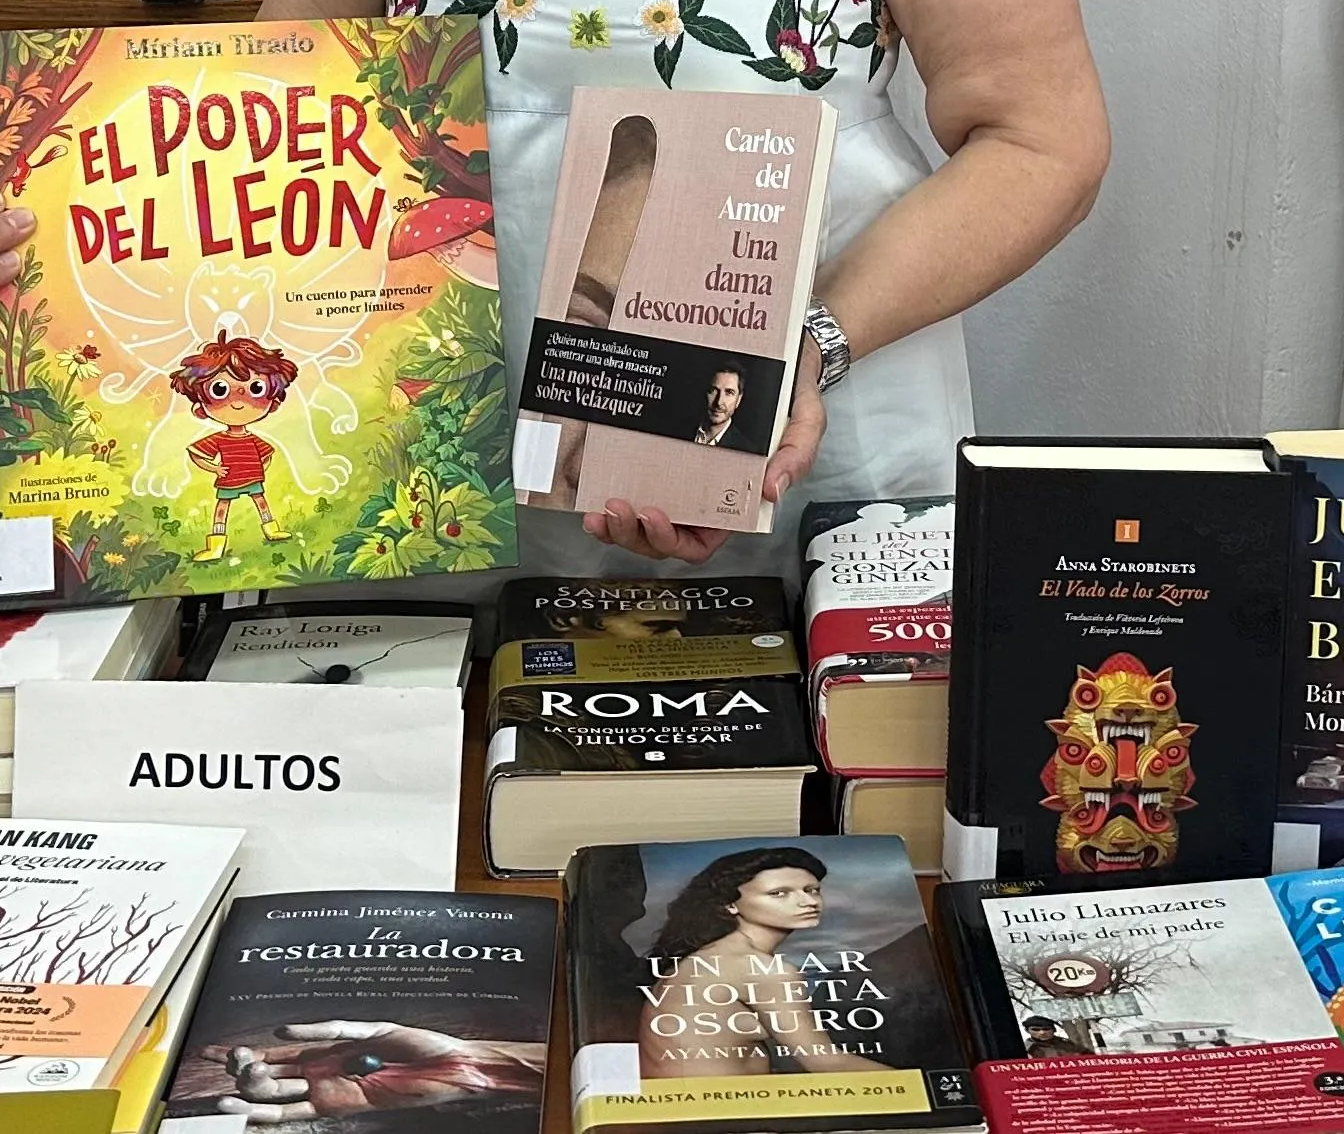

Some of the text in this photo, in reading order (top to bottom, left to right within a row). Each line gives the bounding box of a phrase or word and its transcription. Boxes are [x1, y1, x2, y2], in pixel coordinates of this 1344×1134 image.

[125, 33, 314, 61] Míriam Tirado
[77, 84, 382, 186] EL PODER
[724, 127, 795, 156] Carlos
[755, 163, 790, 190] del
[68, 159, 385, 264] DEL LEÓN
[718, 196, 786, 223] Amor
[731, 231, 778, 261] Una
[704, 264, 773, 295] dama
[285, 283, 433, 303] Un cuento para aprender
[624, 291, 767, 331] desconocida
[7, 484, 110, 504] Marina Bruno
[832, 572, 934, 583] GINER
[1056, 556, 1196, 574] ANNA STAROBINETS
[535, 597, 754, 610] POSTEGUILLO
[558, 586, 729, 600] SANTIAGO
[1039, 580, 1210, 607] El Vado de los Zorros
[239, 619, 383, 642] Ray Loriga
[869, 623, 951, 642] 500
[232, 635, 339, 653] Rendición
[541, 691, 770, 717] ROMA
[575, 732, 733, 746] JULIO CÉSAR
[129, 753, 342, 793] ADULTOS
[26, 831, 98, 850] KANG
[266, 906, 514, 920] Carmina Jiménez Varona
[1001, 895, 1226, 929] Julio Llamazares
[367, 926, 401, 941] La
[1008, 919, 1225, 944] El viaje de mi padre
[238, 939, 525, 963] restauradora
[649, 951, 871, 980] UN MAR
[636, 979, 890, 1007] VIOLETA
[649, 1007, 885, 1038] OSCURO
[660, 1041, 883, 1062] AYANTA BARILLI
[605, 1084, 906, 1106] FINALISTA PREMIO PLANETA 2018
